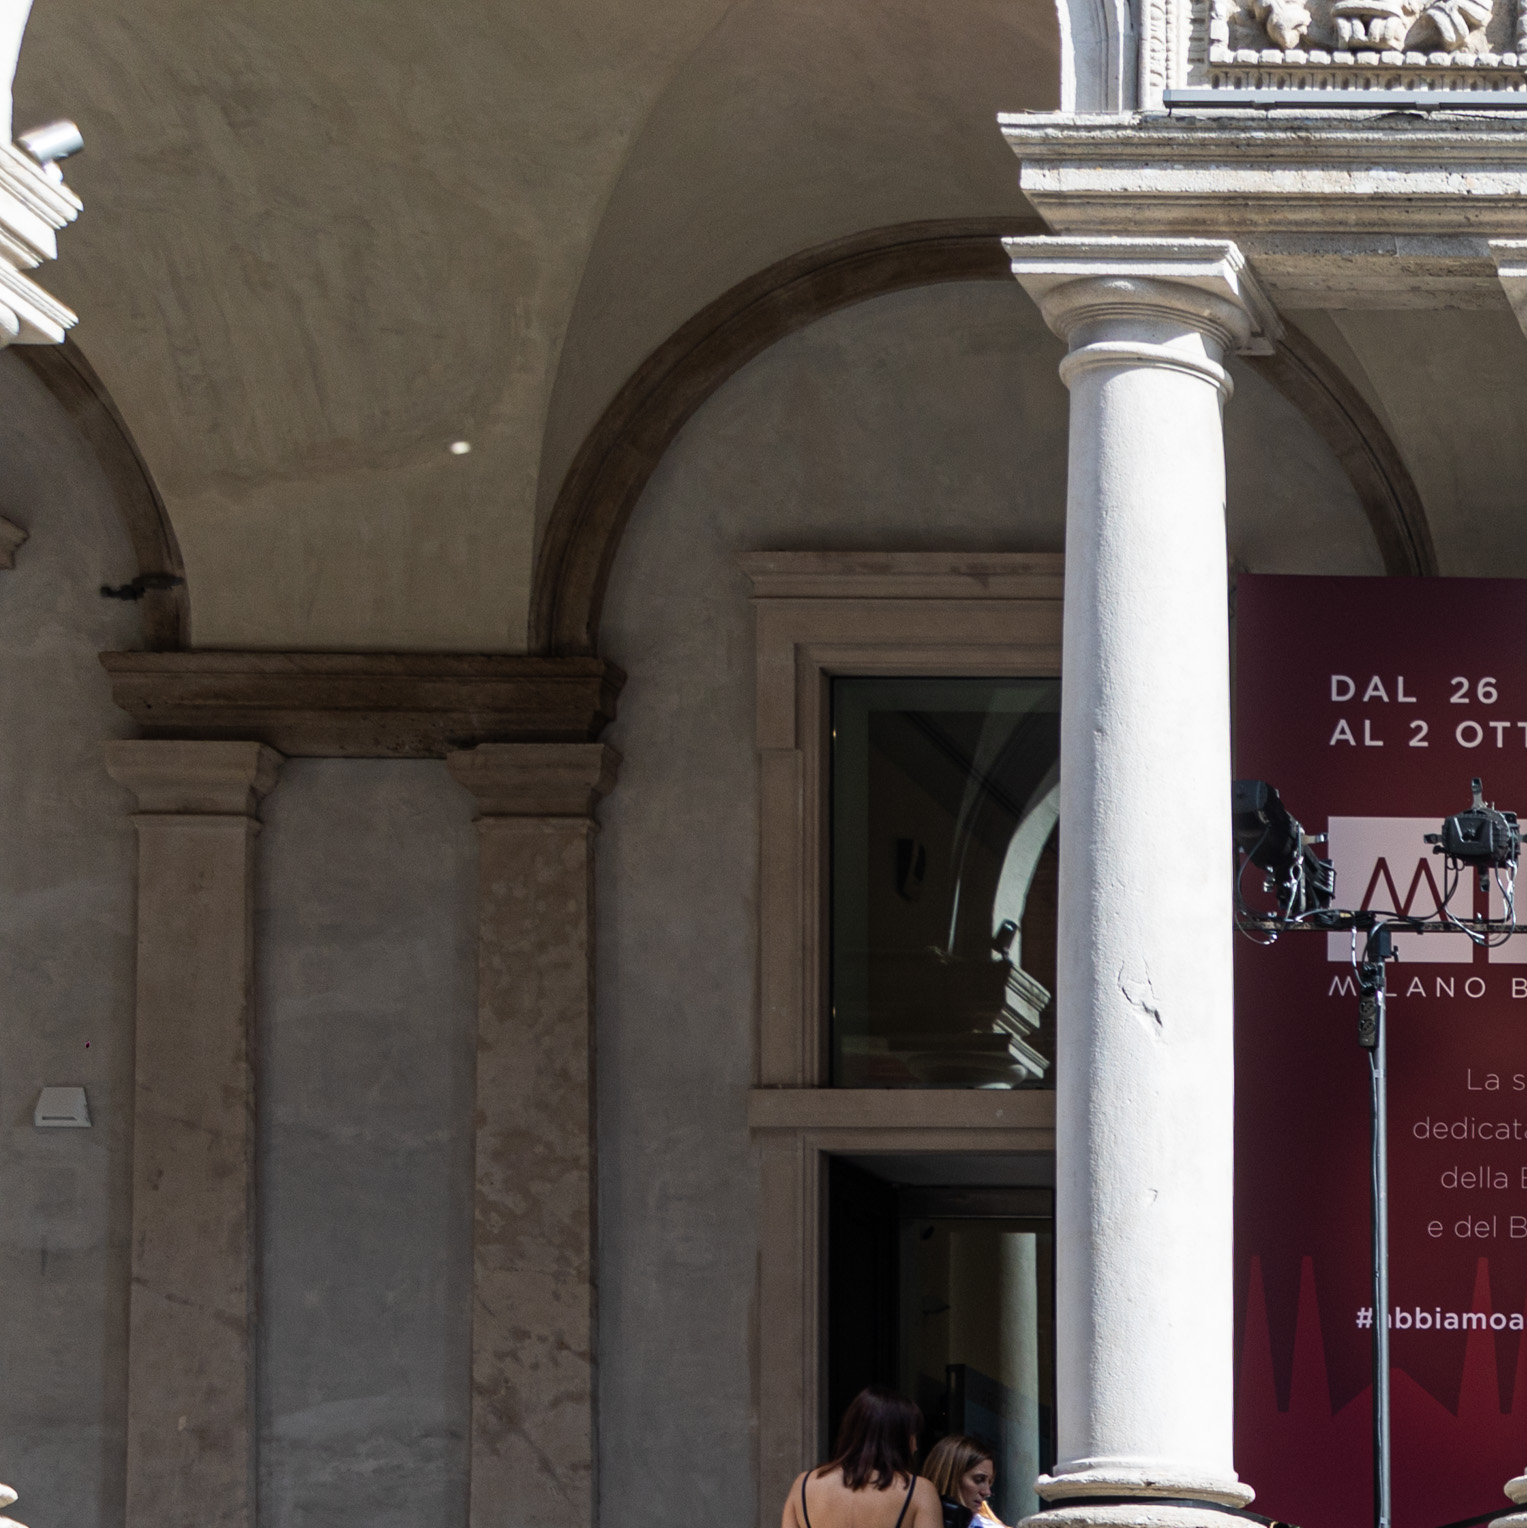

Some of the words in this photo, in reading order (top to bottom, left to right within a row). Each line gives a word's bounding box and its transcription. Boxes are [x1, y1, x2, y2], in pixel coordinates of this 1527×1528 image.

[1331, 675, 1417, 702] DAL
[1450, 676, 1498, 704] 26
[1329, 719, 1384, 746] AL
[1409, 720, 1429, 747] 2
[1468, 1069, 1499, 1090] La
[1441, 1166, 1508, 1189] della
[1428, 1220, 1443, 1238] e
[1455, 1215, 1497, 1238] del
